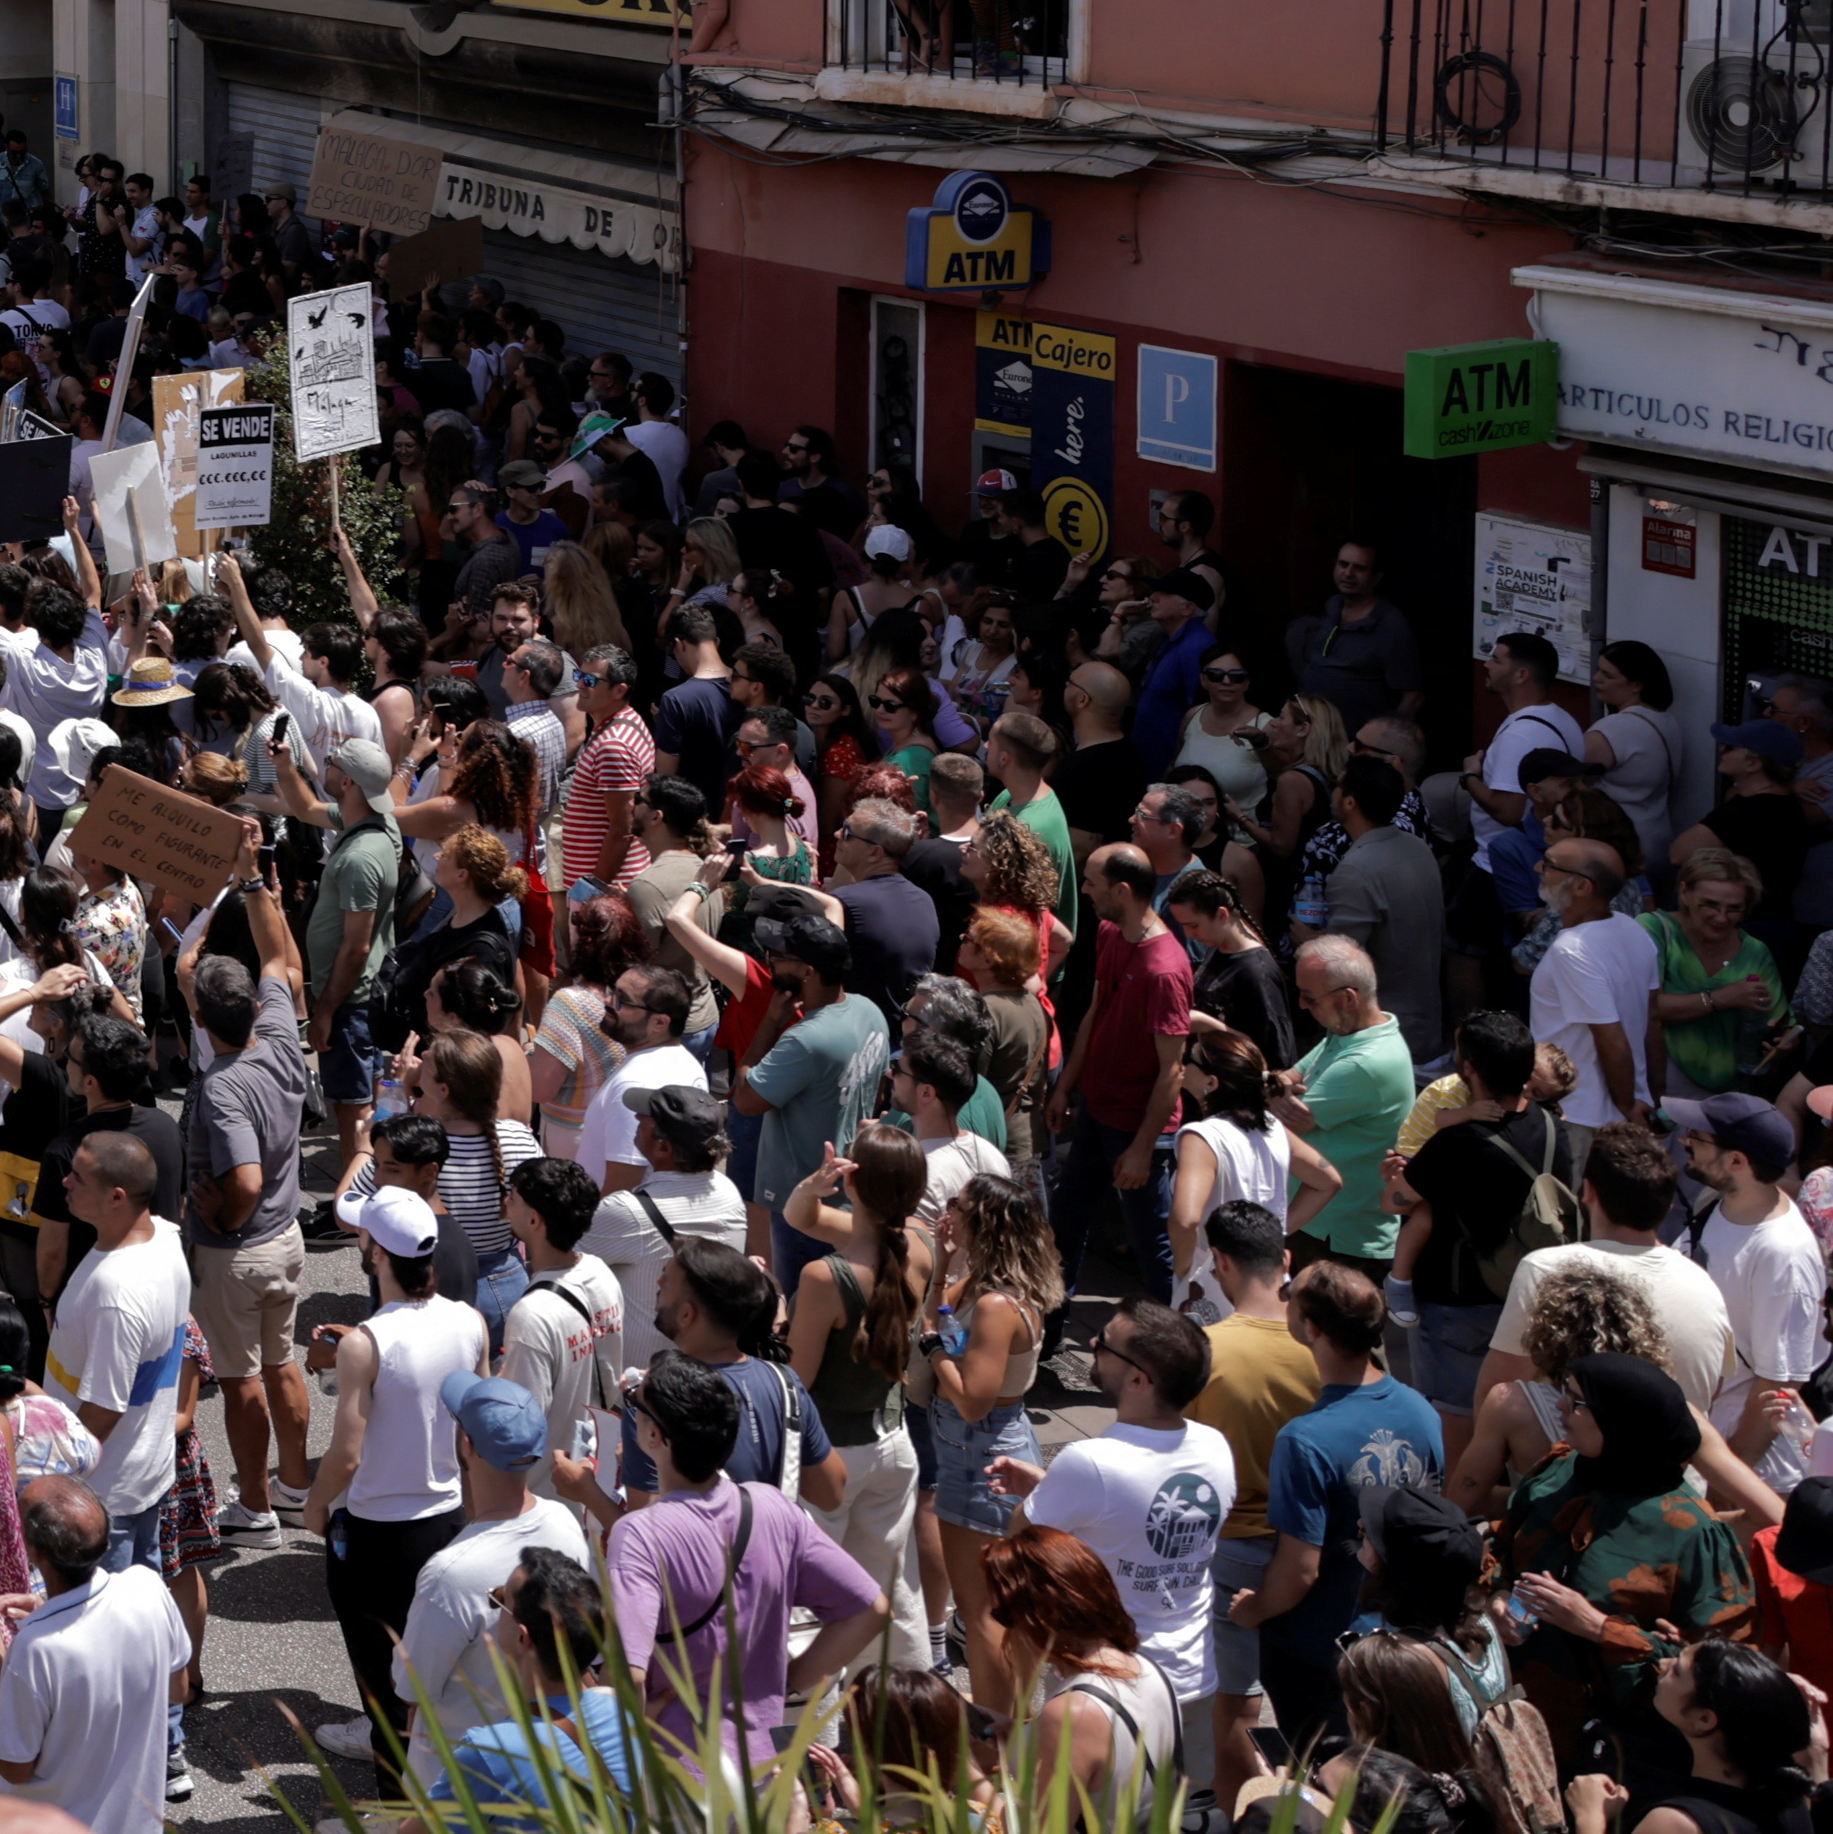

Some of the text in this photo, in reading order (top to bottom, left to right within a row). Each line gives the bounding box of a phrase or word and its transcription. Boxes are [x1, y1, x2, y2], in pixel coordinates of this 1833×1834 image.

[60, 82, 71, 111] H
[321, 133, 389, 172] MÁLAGA
[341, 170, 420, 203] CIUDAD DE
[311, 187, 430, 231] ESPECULADORES
[447, 175, 546, 222] TRIBUNA
[584, 205, 614, 238] DE
[943, 250, 1015, 283] ATM
[1035, 333, 1112, 371] Cajero
[1162, 372, 1189, 424] P
[1441, 359, 1532, 417] ATM
[1558, 382, 1710, 431] ARTICULOS
[201, 416, 269, 441] SE VENDE
[211, 450, 258, 461] LAGUNILLAS
[1646, 521, 1692, 541] Alarma
[1495, 577, 1557, 600] ACADEMY
[1496, 564, 1558, 588] SPANISH
[117, 787, 212, 837] ME ALQUILO
[108, 809, 228, 869] COMO FIGURANTE
[101, 835, 206, 889] EN EL CENTRO
[1116, 1559, 1135, 1578] THE
[1134, 1563, 1158, 1579] GOOD
[1158, 1562, 1175, 1576] SURF
